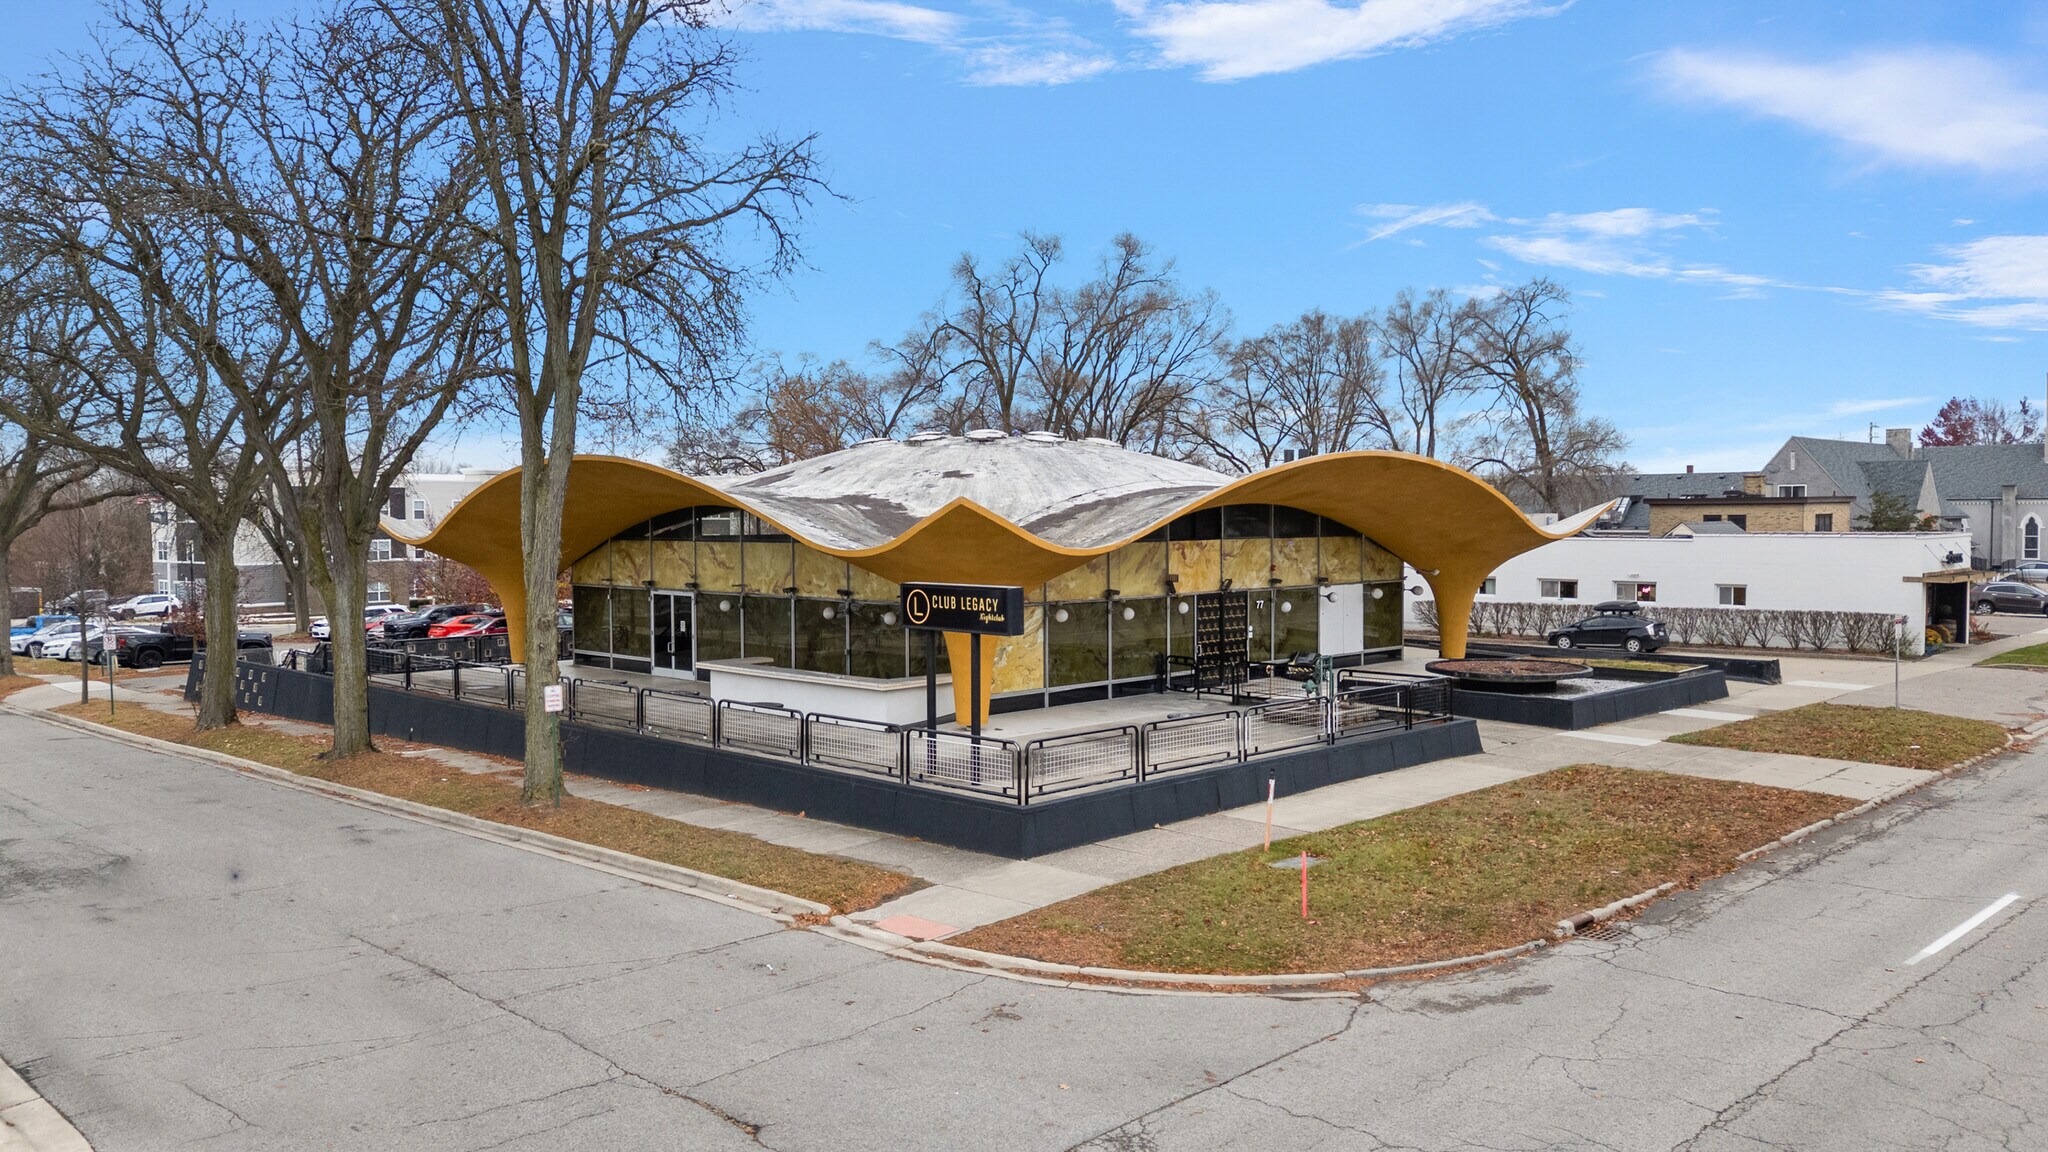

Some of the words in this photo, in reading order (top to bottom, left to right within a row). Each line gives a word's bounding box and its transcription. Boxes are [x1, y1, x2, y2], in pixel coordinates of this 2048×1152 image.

[932, 595, 956, 609] CLUB
[961, 597, 998, 612] LEGACY
[1256, 600, 1264, 609] 77
